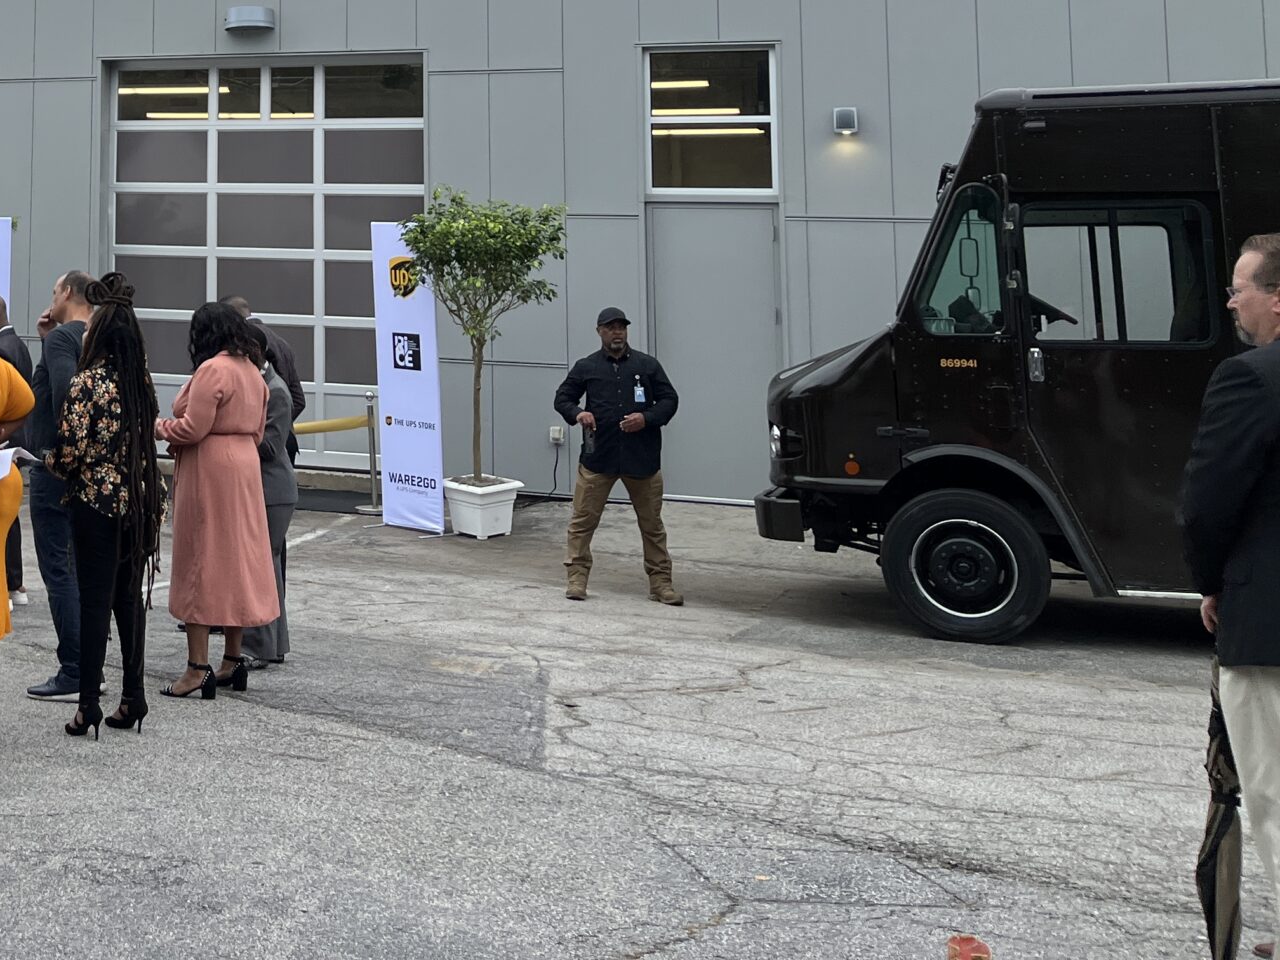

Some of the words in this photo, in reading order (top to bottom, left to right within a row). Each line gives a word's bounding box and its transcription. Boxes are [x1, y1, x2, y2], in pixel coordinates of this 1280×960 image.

[940, 358, 977, 368] 869941
[394, 418, 404, 427] THE
[405, 419, 417, 428] UPS
[418, 421, 436, 431] STORE
[388, 471, 437, 490] WARE2GO
